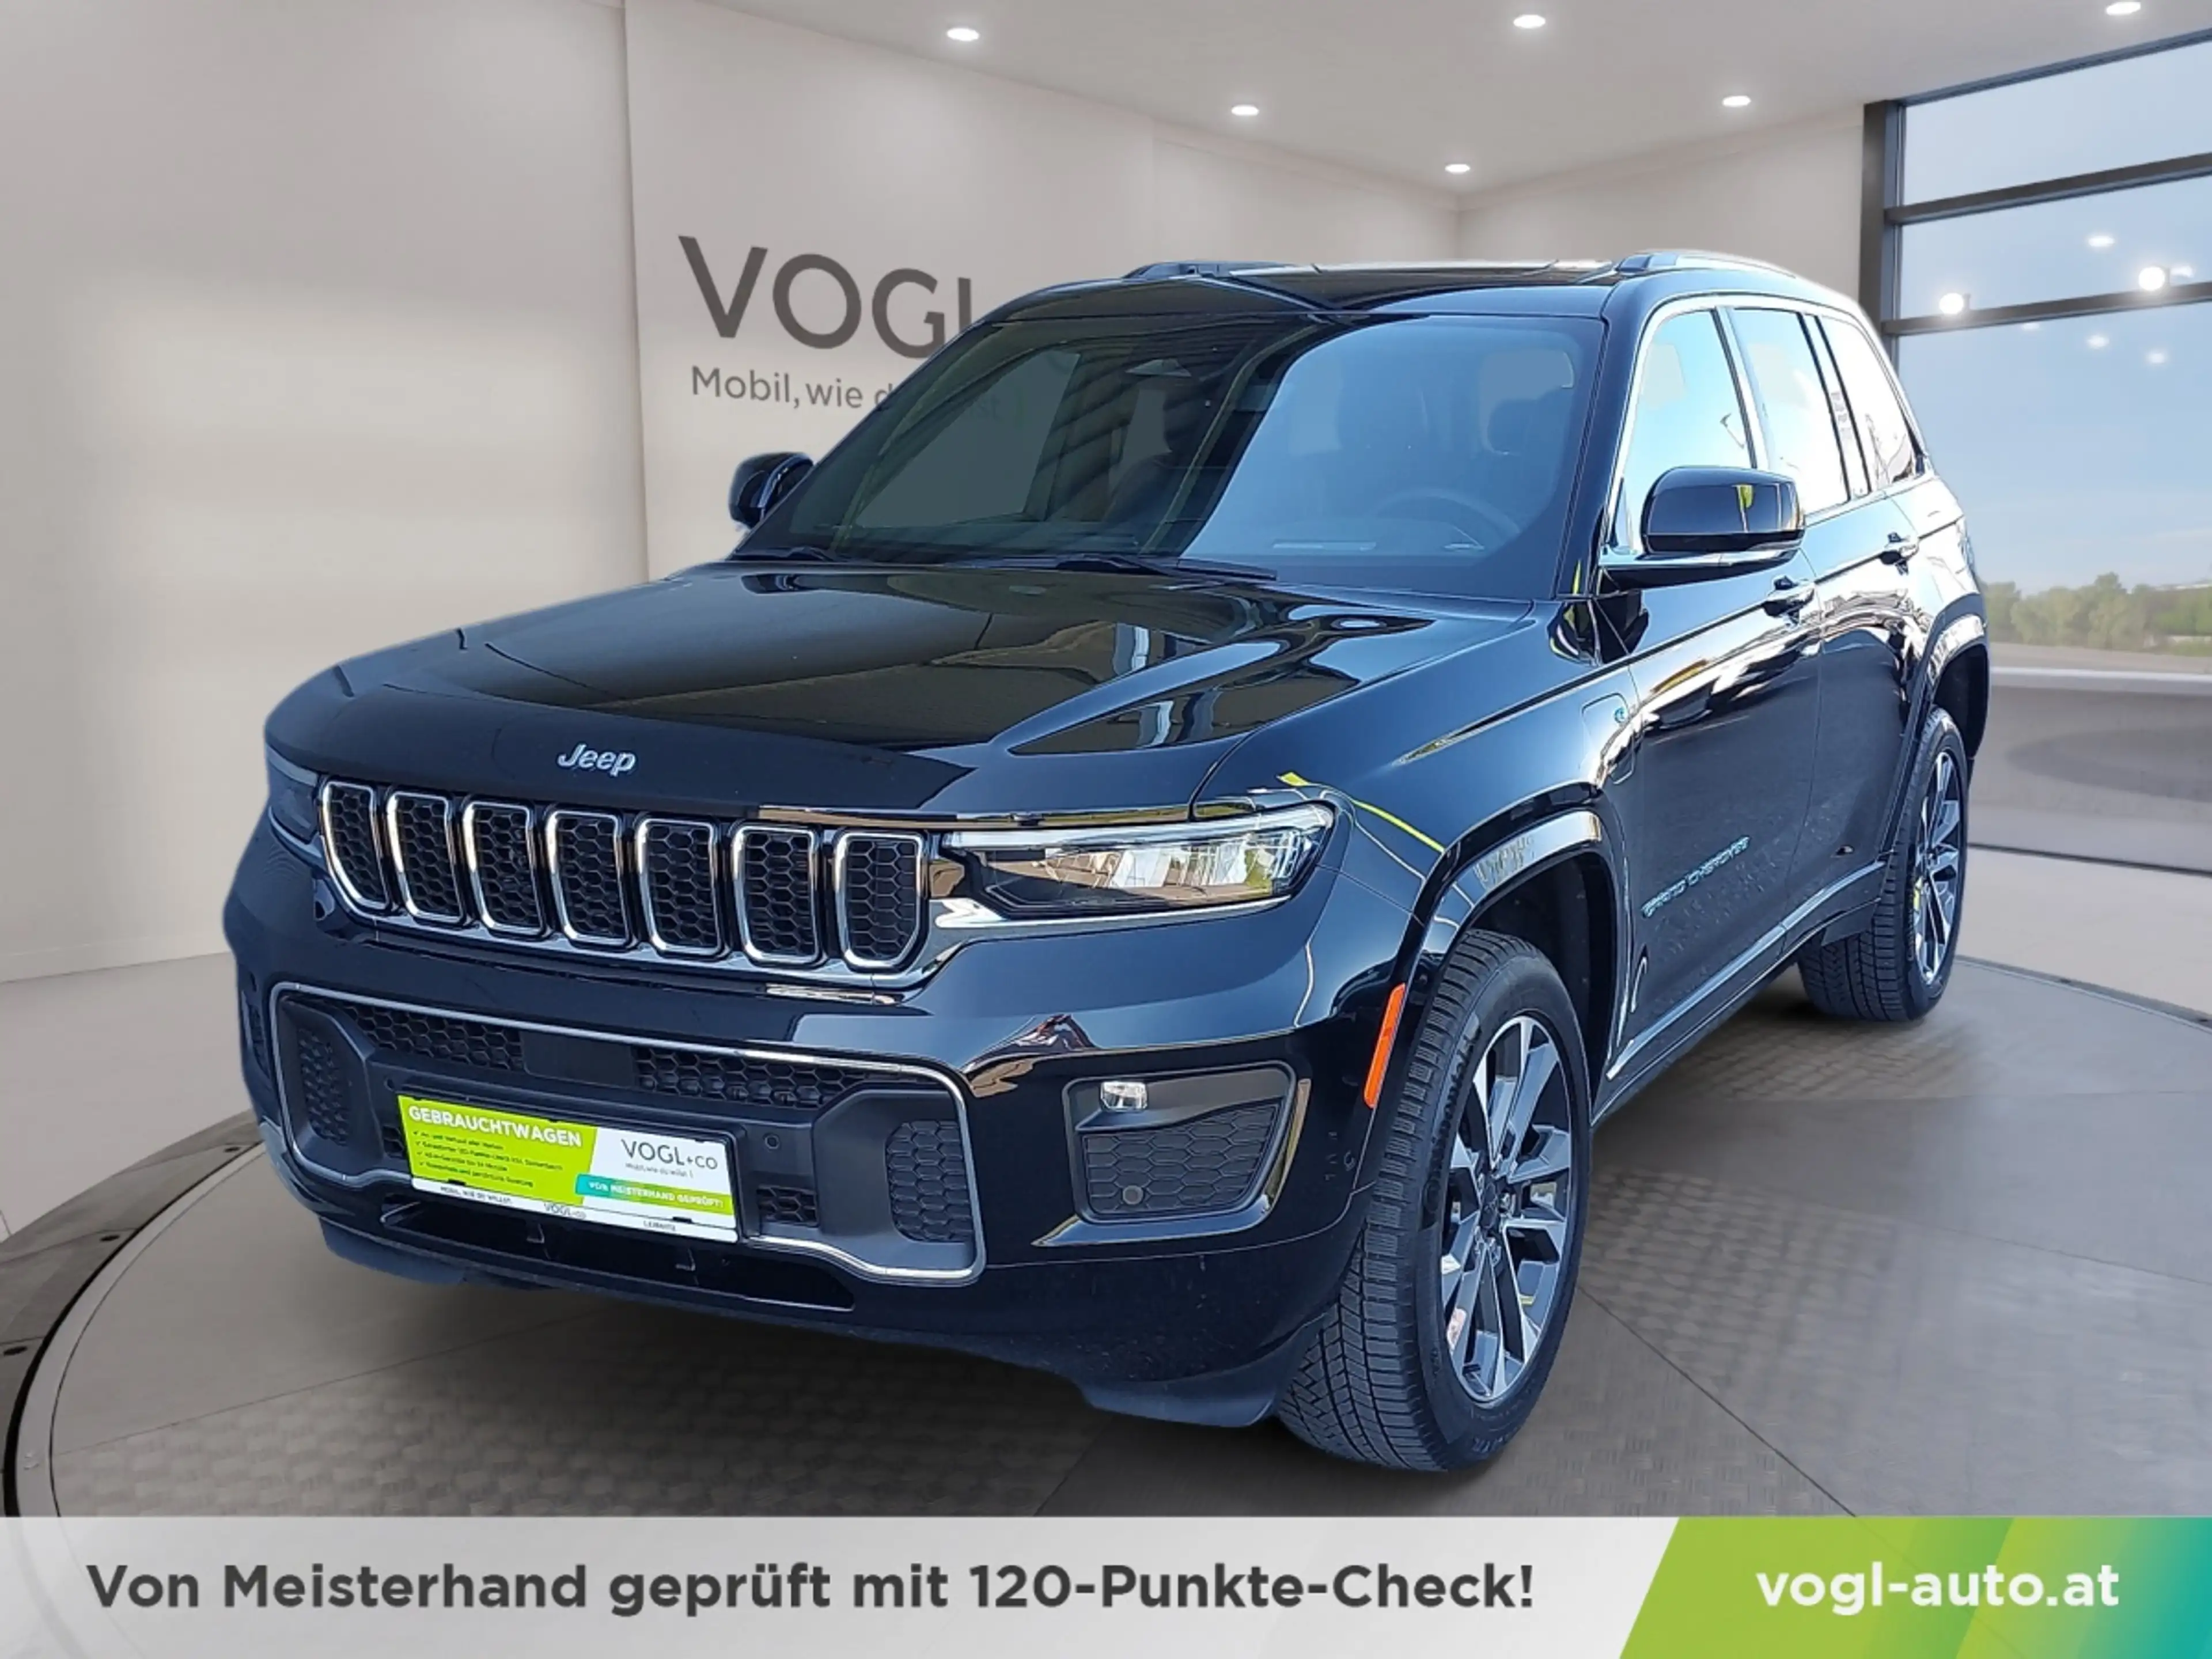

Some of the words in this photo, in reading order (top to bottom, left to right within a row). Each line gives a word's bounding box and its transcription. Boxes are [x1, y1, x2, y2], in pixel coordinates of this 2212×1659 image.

[557, 743, 636, 777] Jeep
[409, 1105, 582, 1147] GEBRAUCHTWAGEN
[609, 1184, 676, 1201] MEISTERHAND
